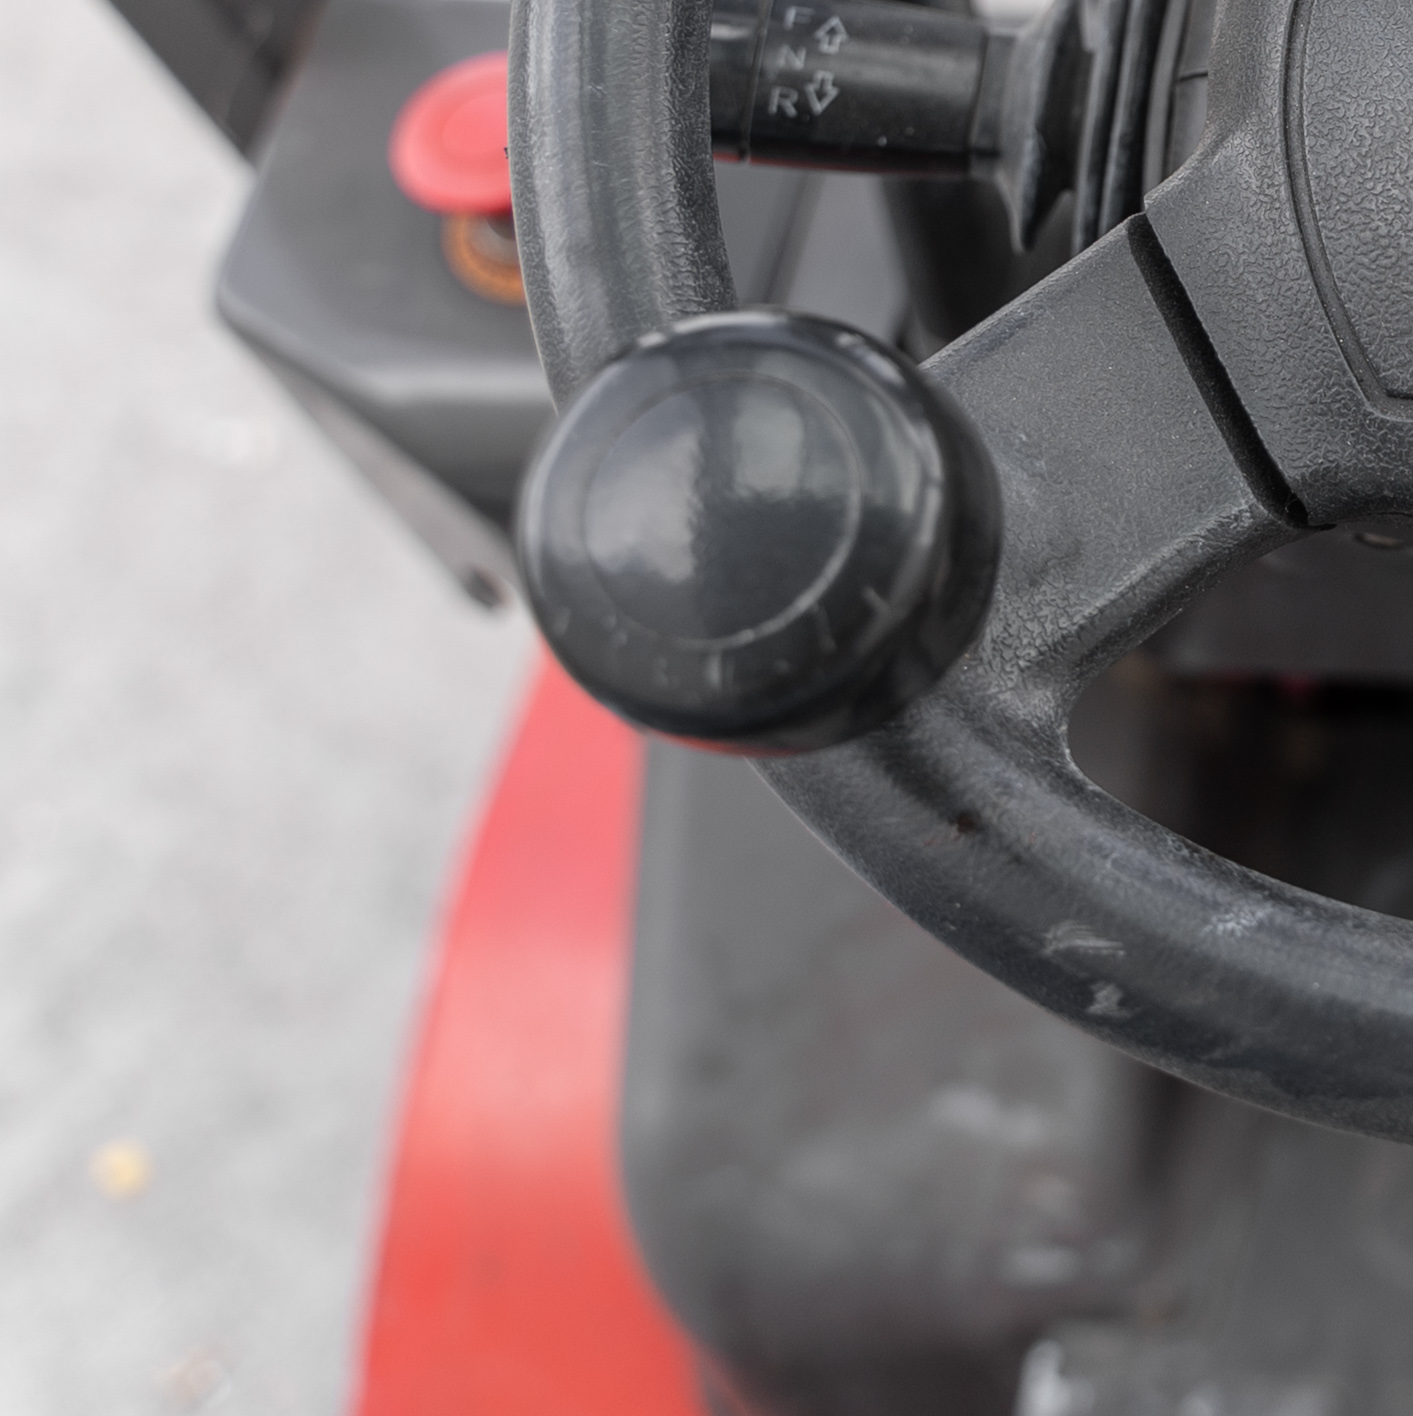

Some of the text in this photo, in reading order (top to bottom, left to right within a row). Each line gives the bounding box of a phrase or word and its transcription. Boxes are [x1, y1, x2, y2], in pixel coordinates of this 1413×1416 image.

[784, 5, 815, 30] F
[777, 44, 807, 71] N
[767, 86, 800, 118] R
